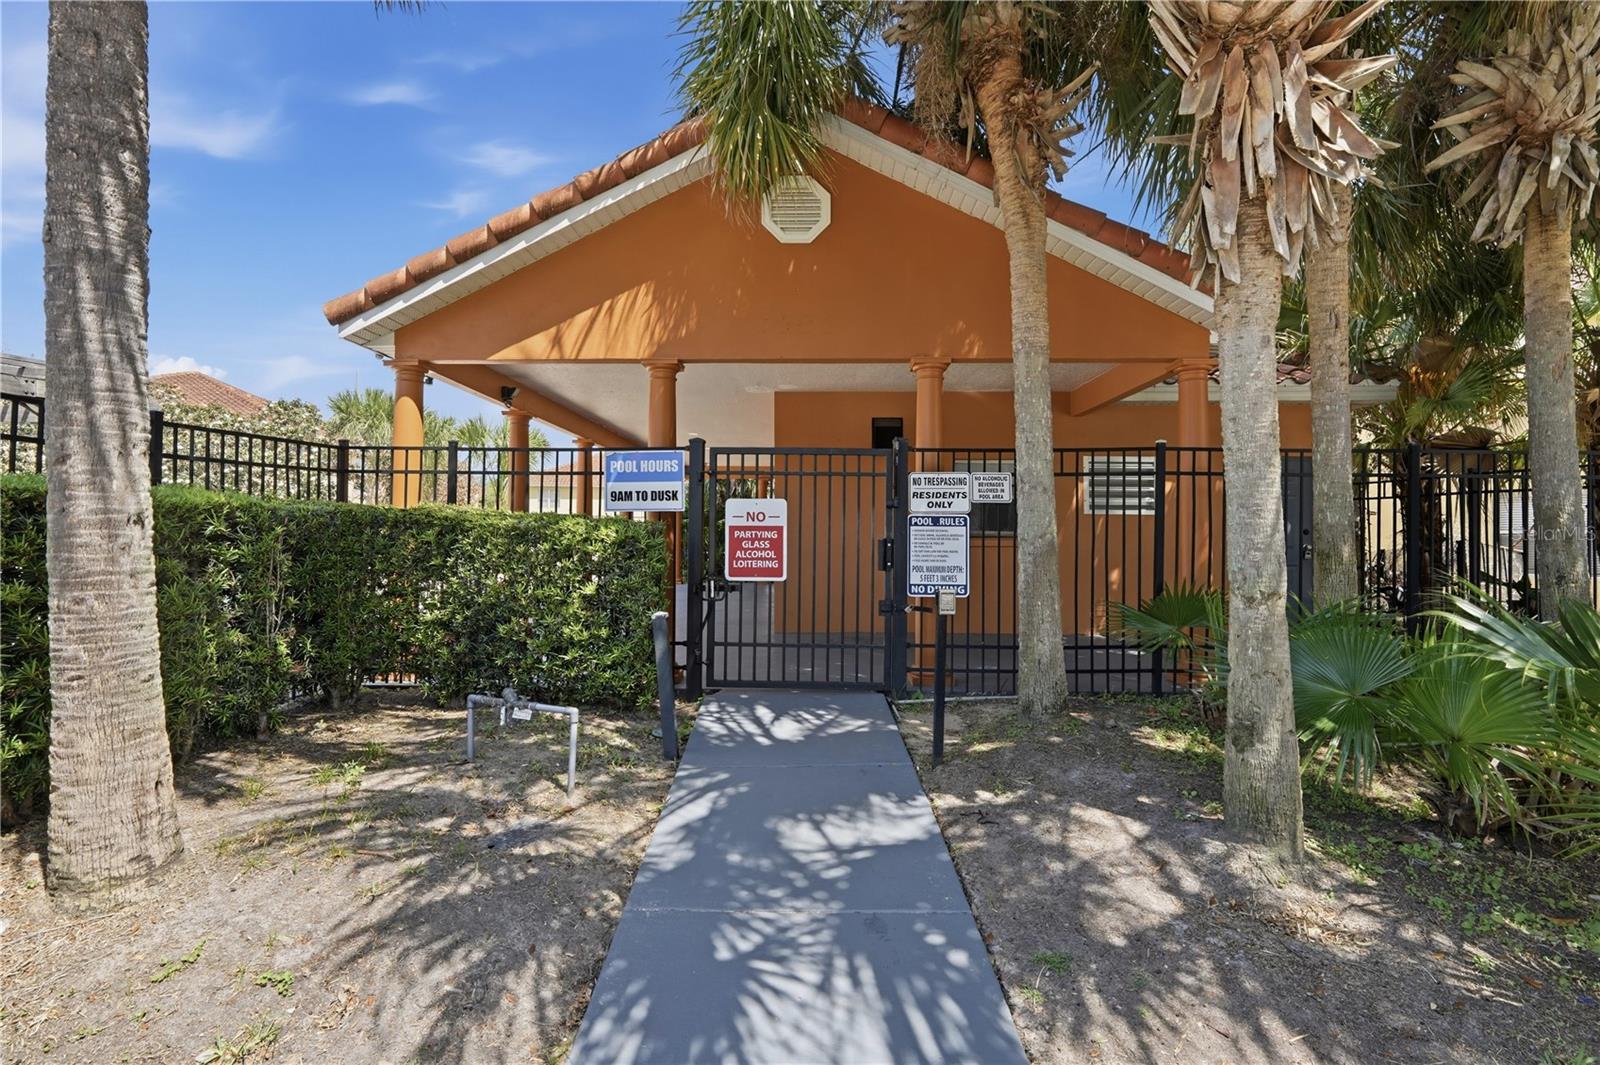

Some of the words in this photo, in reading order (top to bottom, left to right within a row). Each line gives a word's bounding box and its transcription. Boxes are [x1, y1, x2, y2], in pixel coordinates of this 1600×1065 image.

[610, 460, 638, 473] POOL
[640, 459, 679, 473] HOURS
[912, 477, 921, 486] NO
[924, 477, 967, 486] TRESPASSING
[610, 490, 633, 502] 9AM
[635, 490, 648, 502] TO
[650, 490, 679, 502] DUSK
[912, 491, 968, 499] RESIDENTS
[927, 501, 953, 509] ONLY
[746, 511, 766, 522] NO
[911, 517, 934, 526] POOL
[734, 530, 778, 538] PARTYING
[742, 540, 770, 548] GLASS
[735, 550, 776, 558] ALCOHOL
[733, 560, 779, 568] LOITERING
[912, 565, 925, 573] POOL
[923, 575, 935, 583] FEET
[935, 575, 939, 583] 3
[940, 575, 958, 583] INCHES
[911, 585, 925, 593] NO
